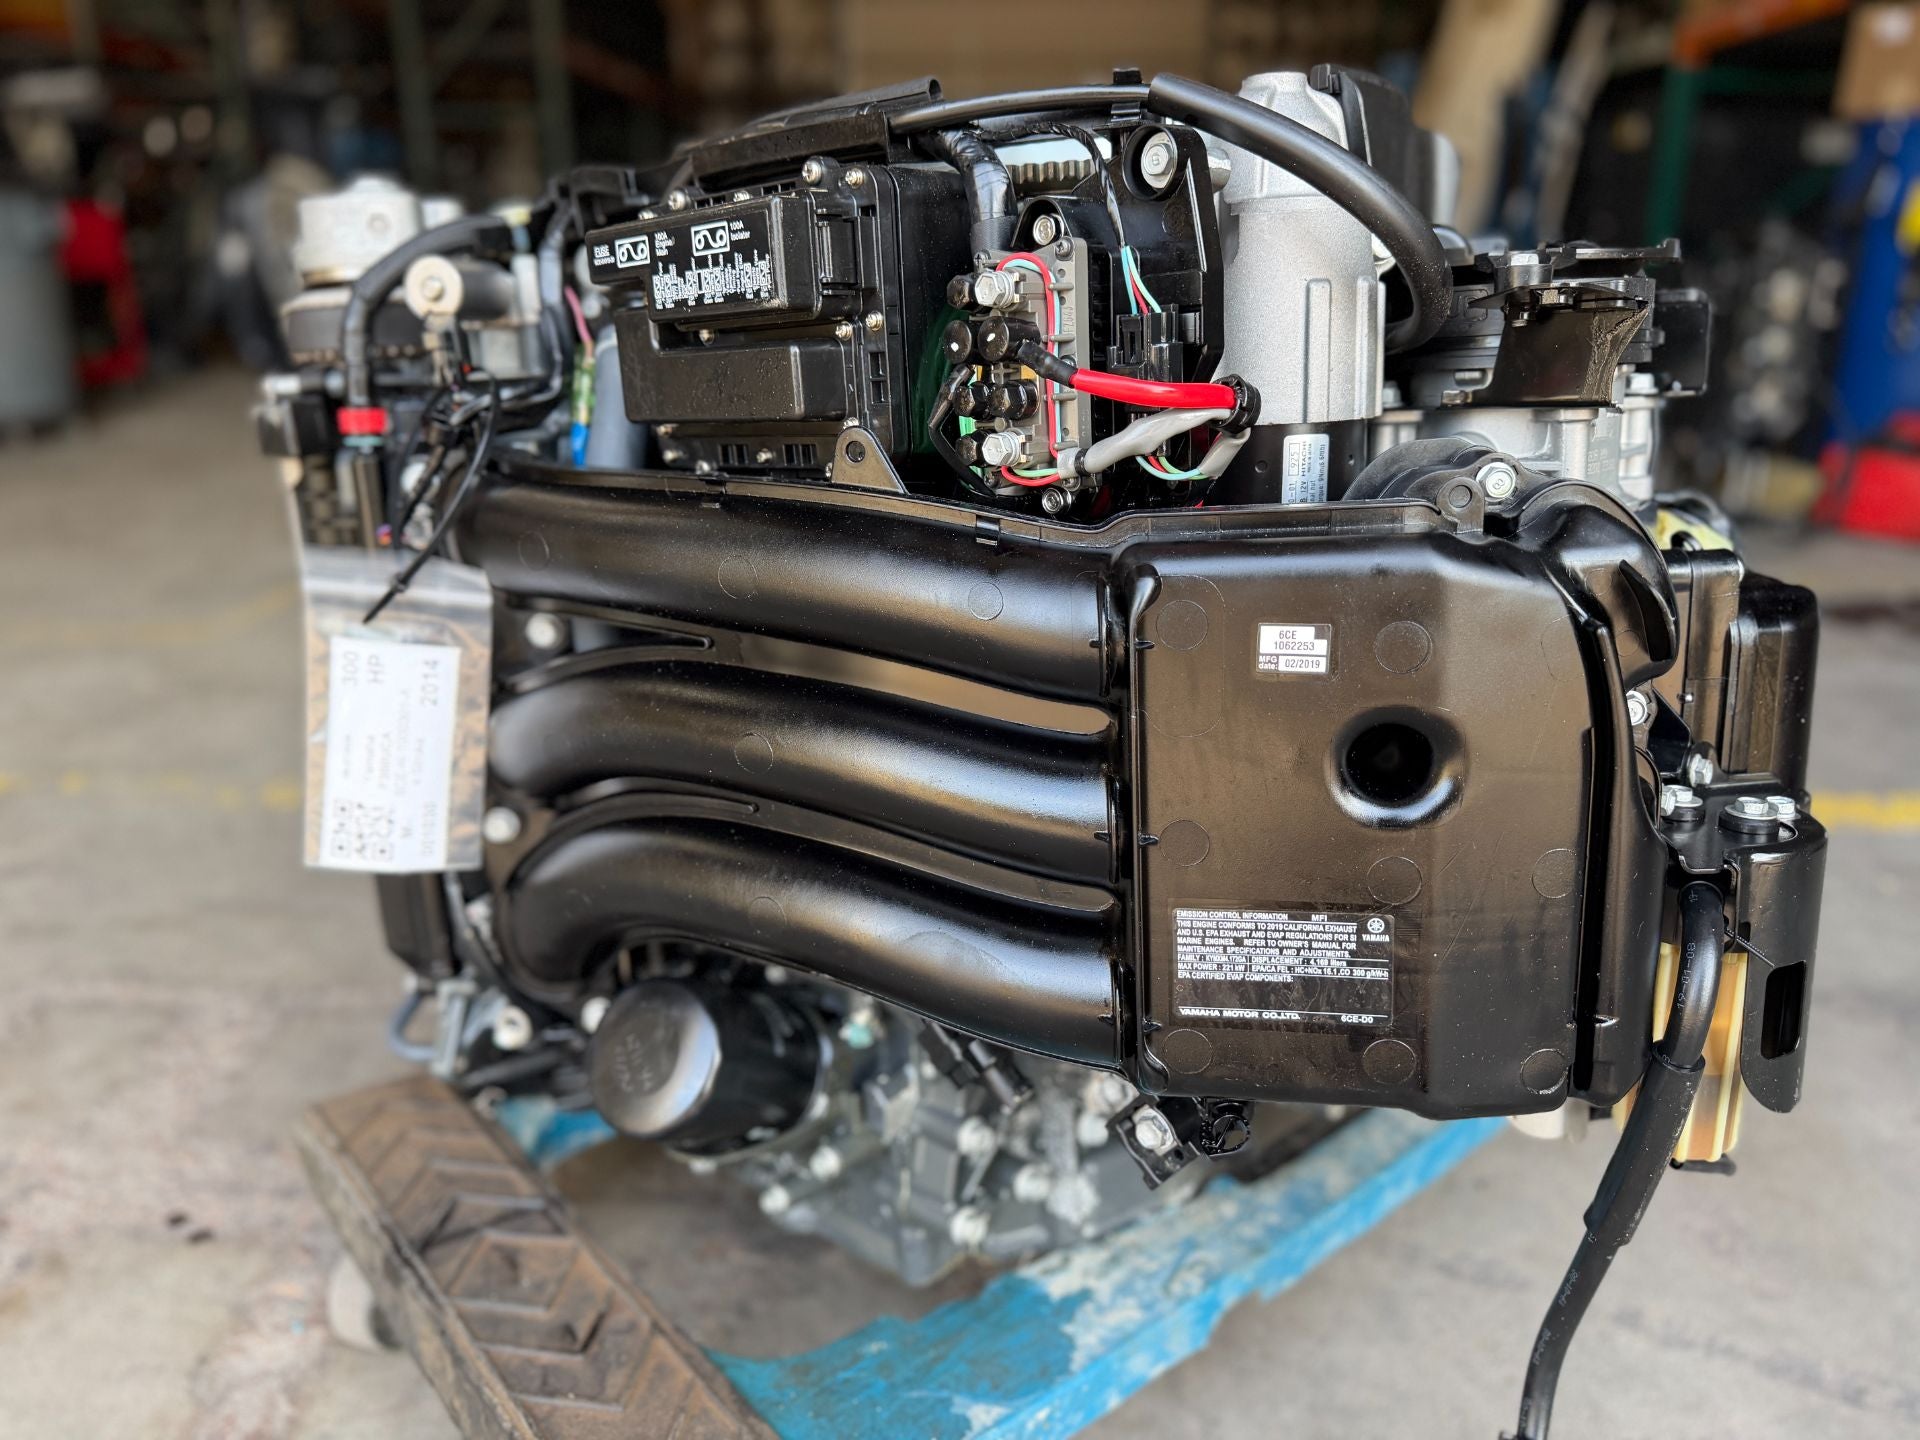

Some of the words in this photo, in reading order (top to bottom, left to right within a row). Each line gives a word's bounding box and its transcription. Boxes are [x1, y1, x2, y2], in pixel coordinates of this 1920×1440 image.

[1279, 630, 1297, 640] 6CE
[1273, 641, 1315, 651] 1062253
[1258, 655, 1277, 663] MFG
[1285, 658, 1321, 669] 02/2019
[1258, 662, 1278, 670] date:
[341, 650, 359, 687] 300
[366, 653, 385, 685] HP
[419, 659, 440, 708] 2014
[1176, 911, 1208, 919] EMISSION
[1242, 912, 1289, 921] INFORMATION
[1311, 914, 1328, 922] MFI
[1177, 920, 1191, 928] THIS
[1192, 920, 1218, 929] ENGINE
[1218, 922, 1256, 930] CONFORMS
[1257, 922, 1267, 930] TO
[1267, 923, 1283, 931] 2019
[1284, 923, 1325, 932] CALIFORNIA
[1325, 924, 1357, 933] EXHAUST
[1192, 929, 1204, 937] U.S.
[1219, 930, 1251, 938] EXHAUST
[1267, 931, 1285, 939] EVAP
[1286, 932, 1332, 941] REGULATIONS
[1334, 933, 1349, 941] FOR
[1362, 934, 1390, 942] YAMAHA
[1177, 937, 1202, 945] MARINE
[1205, 938, 1235, 946] ENGINES.
[1244, 938, 1266, 947] REFER
[1267, 939, 1277, 947] TO
[1277, 939, 1309, 948] OWNER'S
[1312, 941, 1341, 950] MANUAL
[1342, 942, 1357, 950] FOR
[1177, 945, 1224, 954] MAINTENANCE
[1227, 946, 1280, 955] SPECIFICATIONS
[1282, 948, 1297, 956] AND
[1300, 949, 1351, 958] ADJUSTMENTS.
[1178, 954, 1200, 962] FAMILY
[1251, 956, 1304, 965] DISPLACEMENT
[1178, 962, 1192, 970] MAX
[1193, 963, 1218, 971] POWER
[1251, 964, 1276, 973] EPA/CA
[1277, 965, 1290, 973] FEL
[1352, 969, 1366, 977] 300
[1178, 971, 1191, 979] EPA
[1191, 972, 1226, 980] CERTIFIED
[1244, 973, 1294, 982] COMPONENTS:
[1341, 1015, 1374, 1023] 6CE-D0
